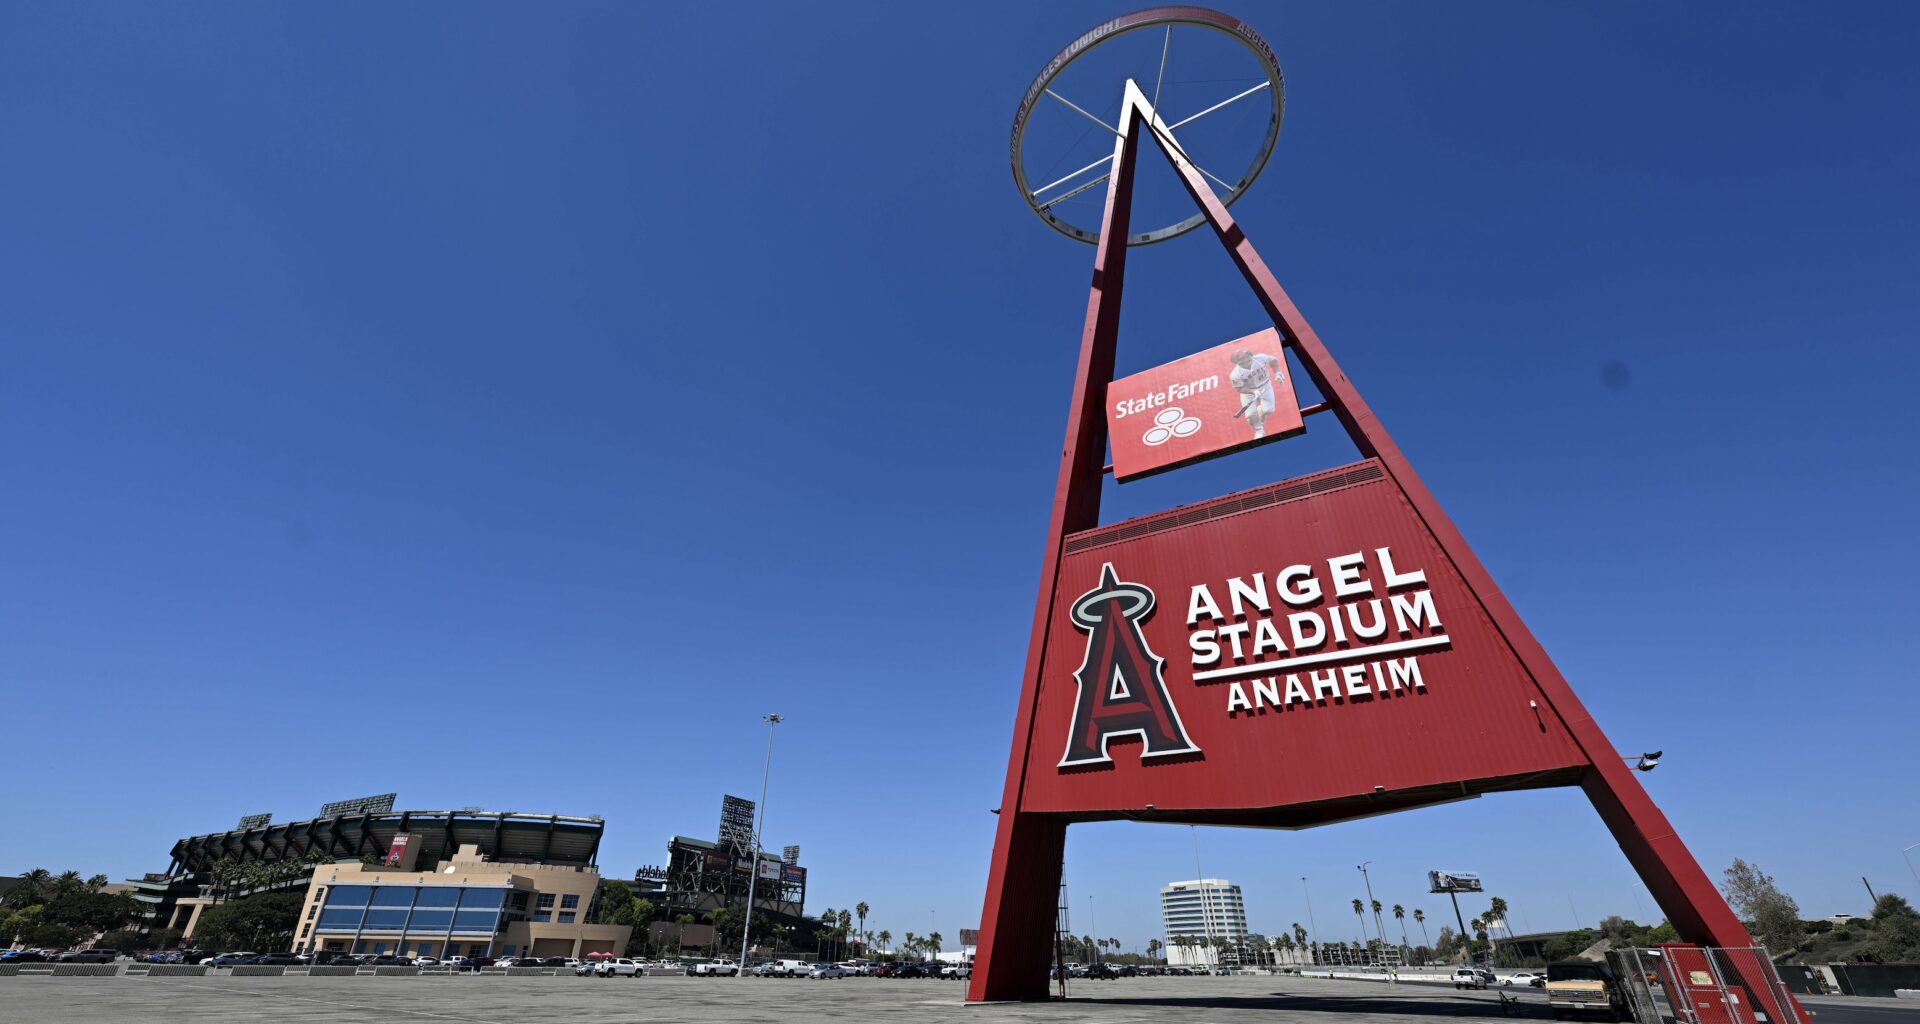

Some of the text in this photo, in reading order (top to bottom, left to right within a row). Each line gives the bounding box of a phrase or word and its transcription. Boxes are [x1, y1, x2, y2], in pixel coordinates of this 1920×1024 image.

[1023, 55, 1061, 108] YANKEES
[1064, 17, 1120, 60] TONIGHT
[1236, 22, 1272, 58] ANGELS
[1186, 546, 1428, 625] ANGEL
[1188, 589, 1443, 664] STADIUM
[1227, 656, 1425, 712] ANAHEIM
